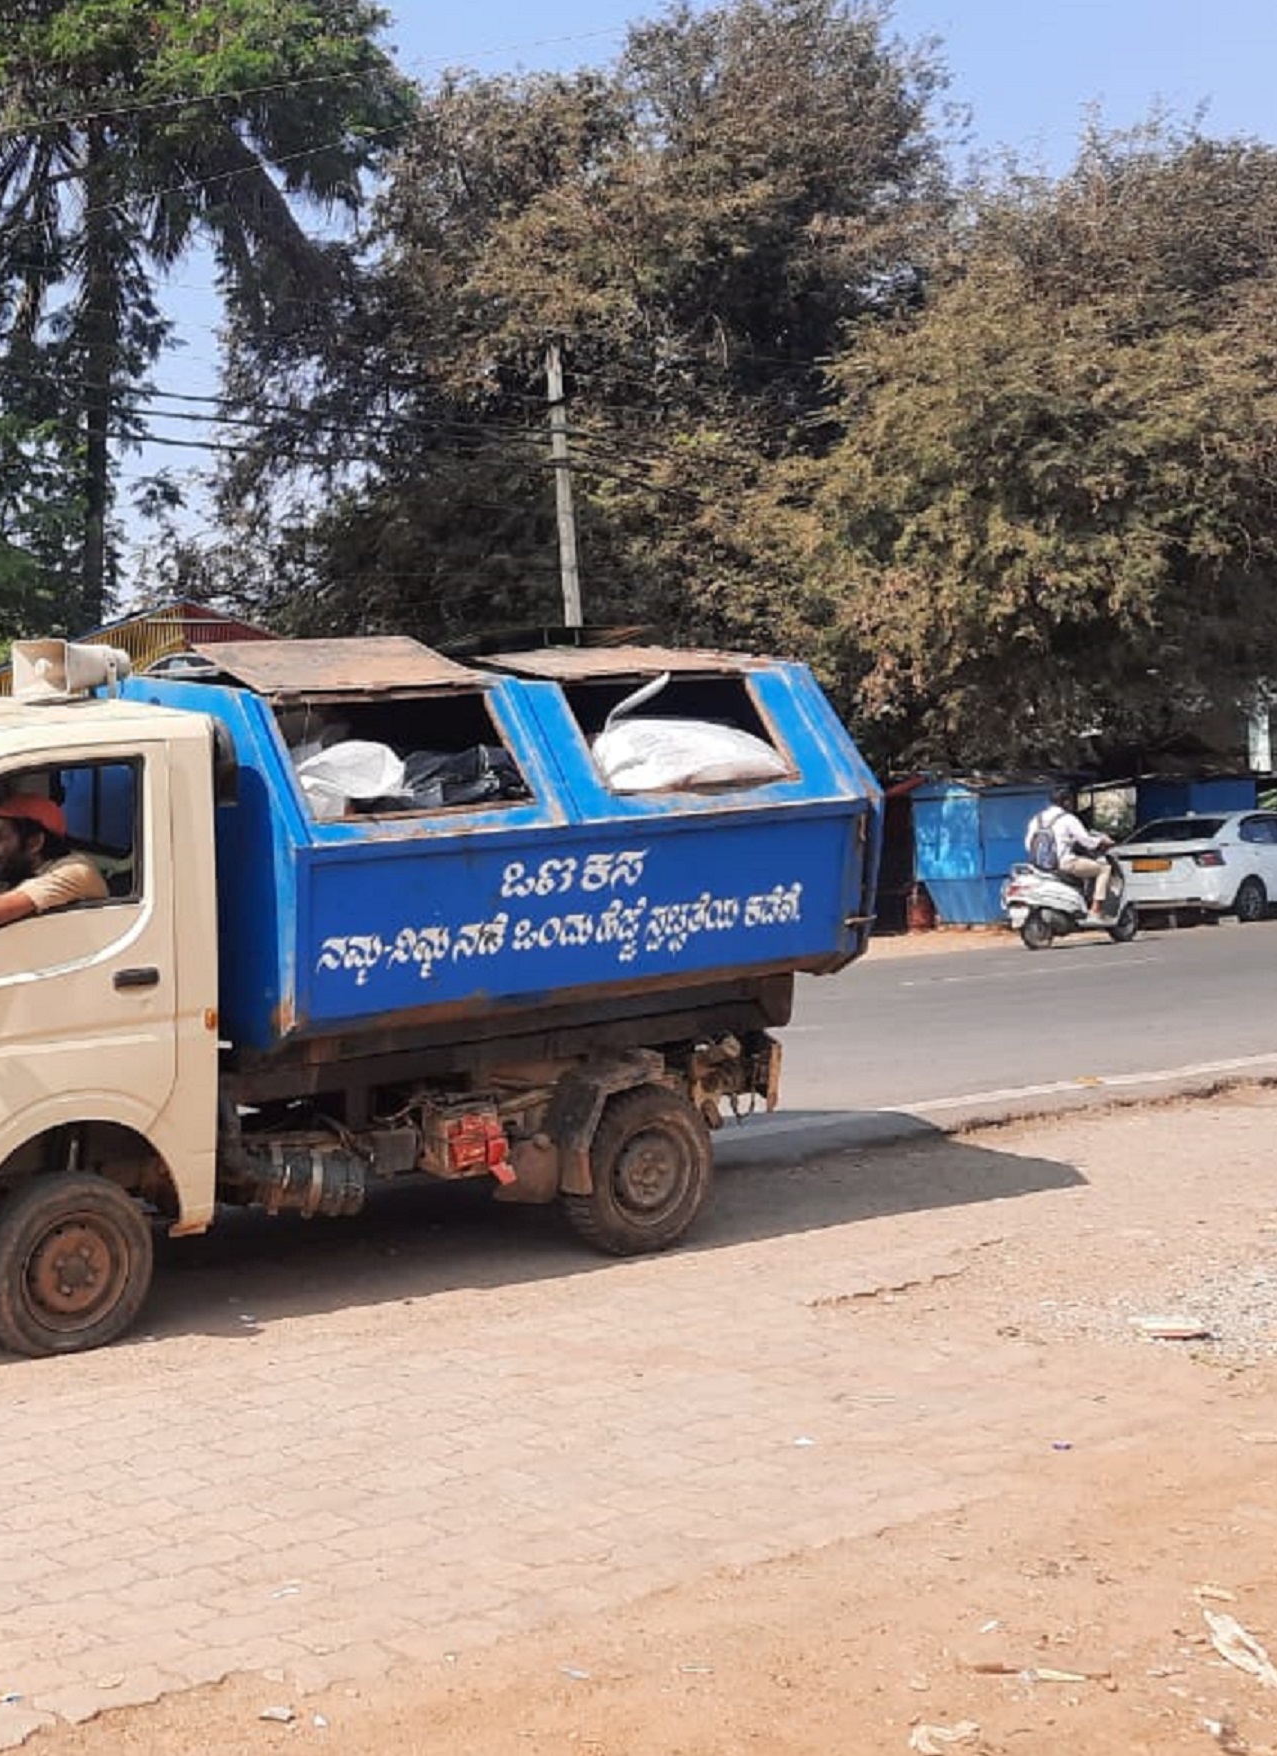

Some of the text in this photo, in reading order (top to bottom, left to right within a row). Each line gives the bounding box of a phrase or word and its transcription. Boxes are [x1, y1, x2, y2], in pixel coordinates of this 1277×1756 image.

[501, 848, 650, 898] ಒಣ ಕಸ
[452, 911, 509, 963] ನಡೆ
[512, 914, 594, 951] ಒಂದು
[595, 896, 647, 963] ಹೆಜ್ಜೆ
